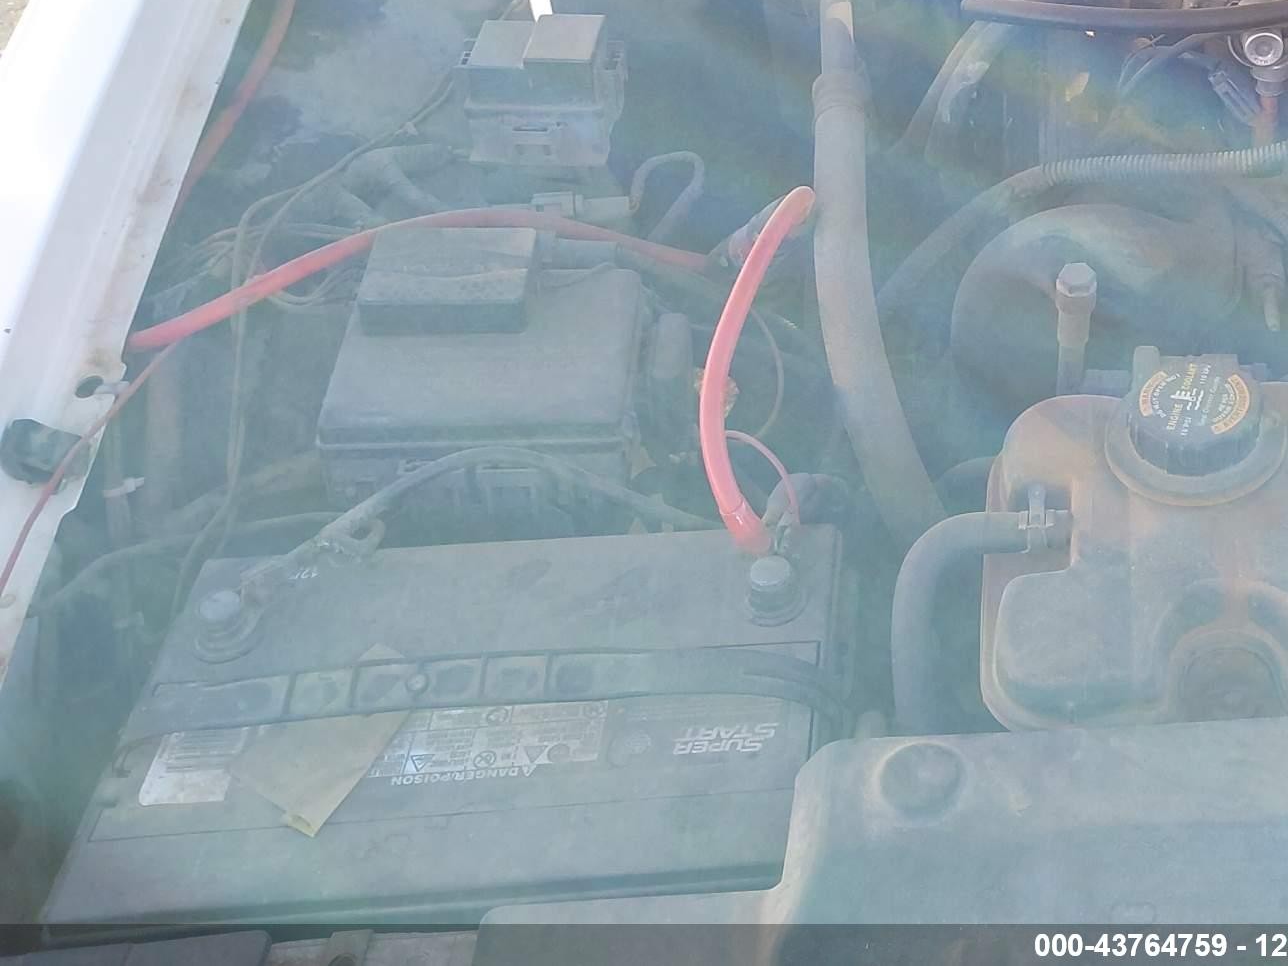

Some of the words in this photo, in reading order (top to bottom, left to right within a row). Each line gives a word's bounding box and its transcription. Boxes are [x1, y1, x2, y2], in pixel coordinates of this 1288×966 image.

[1166, 403, 1184, 431] ENGINE
[1181, 362, 1197, 391] COOLANT
[673, 722, 779, 740] START
[672, 737, 765, 755] SUPER
